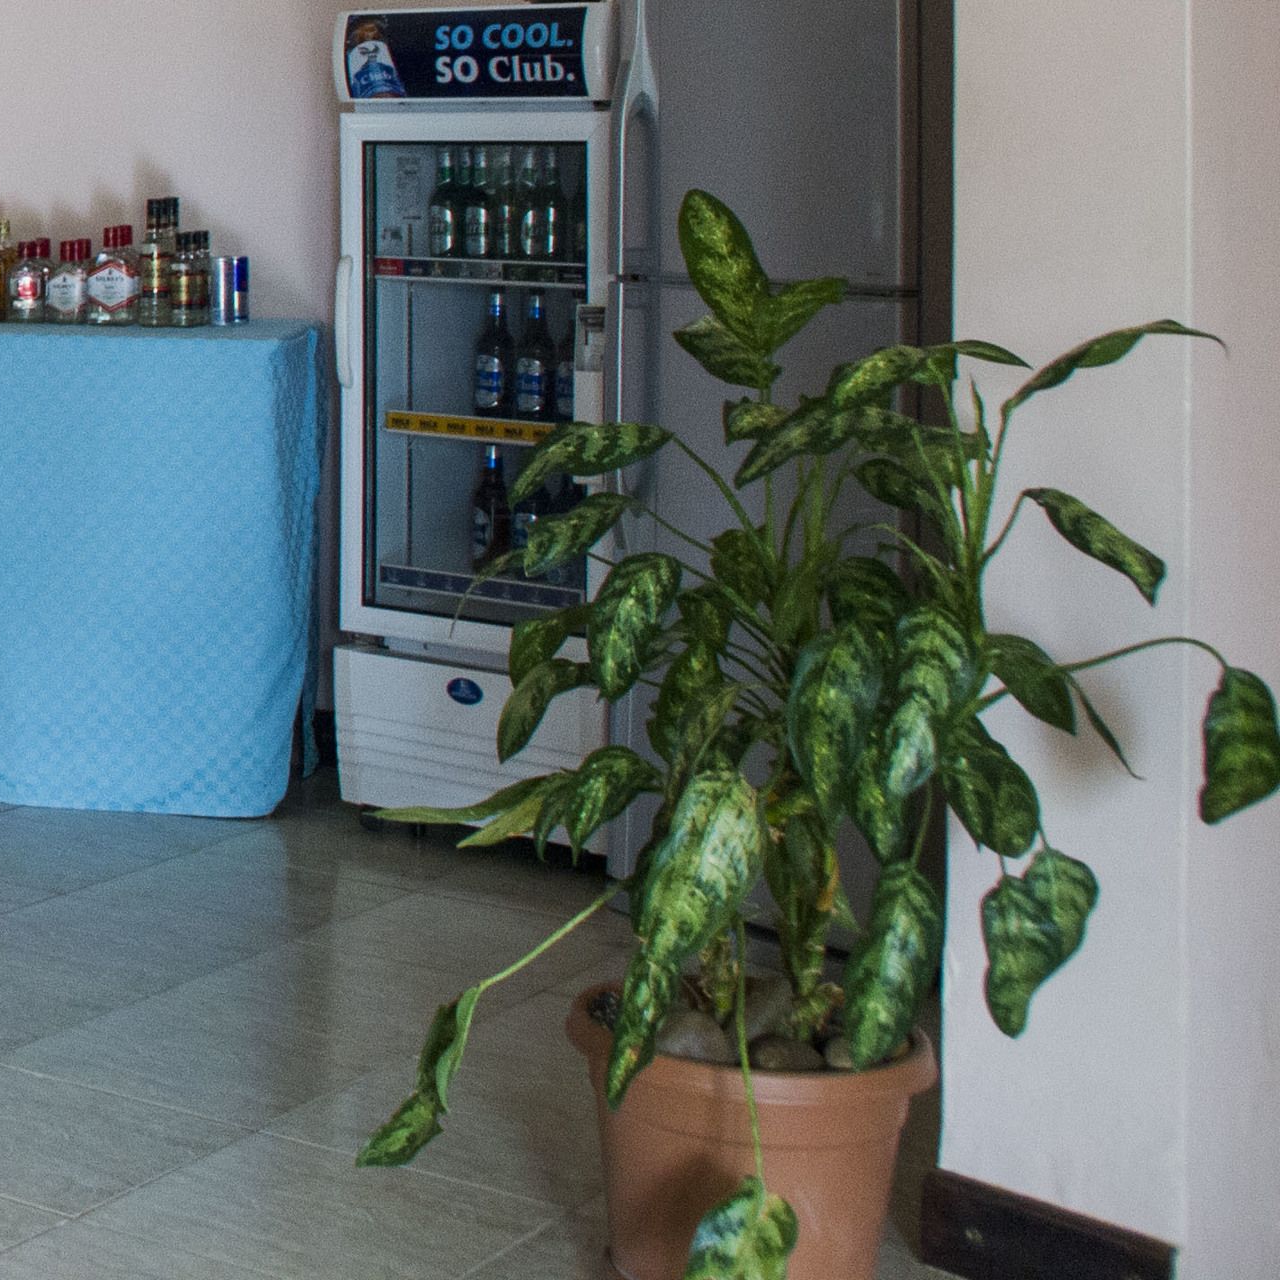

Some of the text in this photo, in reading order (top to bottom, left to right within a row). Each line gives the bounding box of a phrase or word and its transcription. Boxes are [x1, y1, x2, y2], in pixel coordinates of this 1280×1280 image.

[434, 22, 574, 51] SO COOL.
[434, 53, 575, 83] SO Club.
